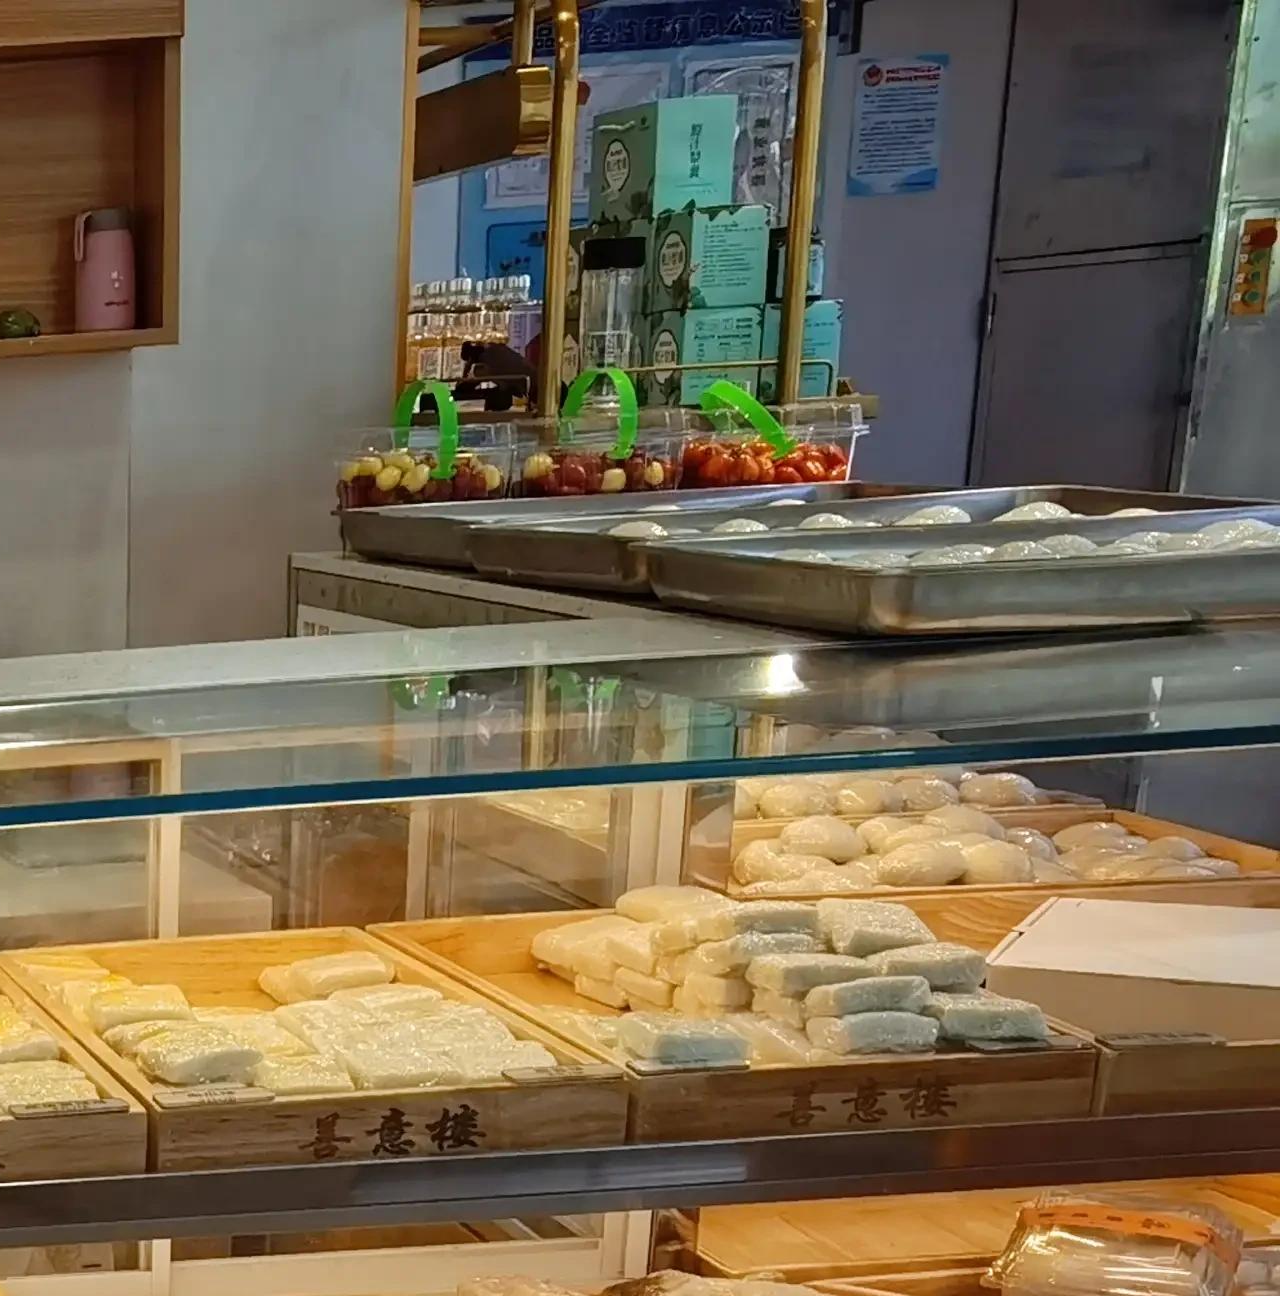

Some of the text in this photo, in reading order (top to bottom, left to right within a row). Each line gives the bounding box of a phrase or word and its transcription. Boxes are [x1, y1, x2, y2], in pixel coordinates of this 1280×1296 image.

[776, 1077, 959, 1129] 善意楼
[299, 1104, 487, 1160] 善意楼
